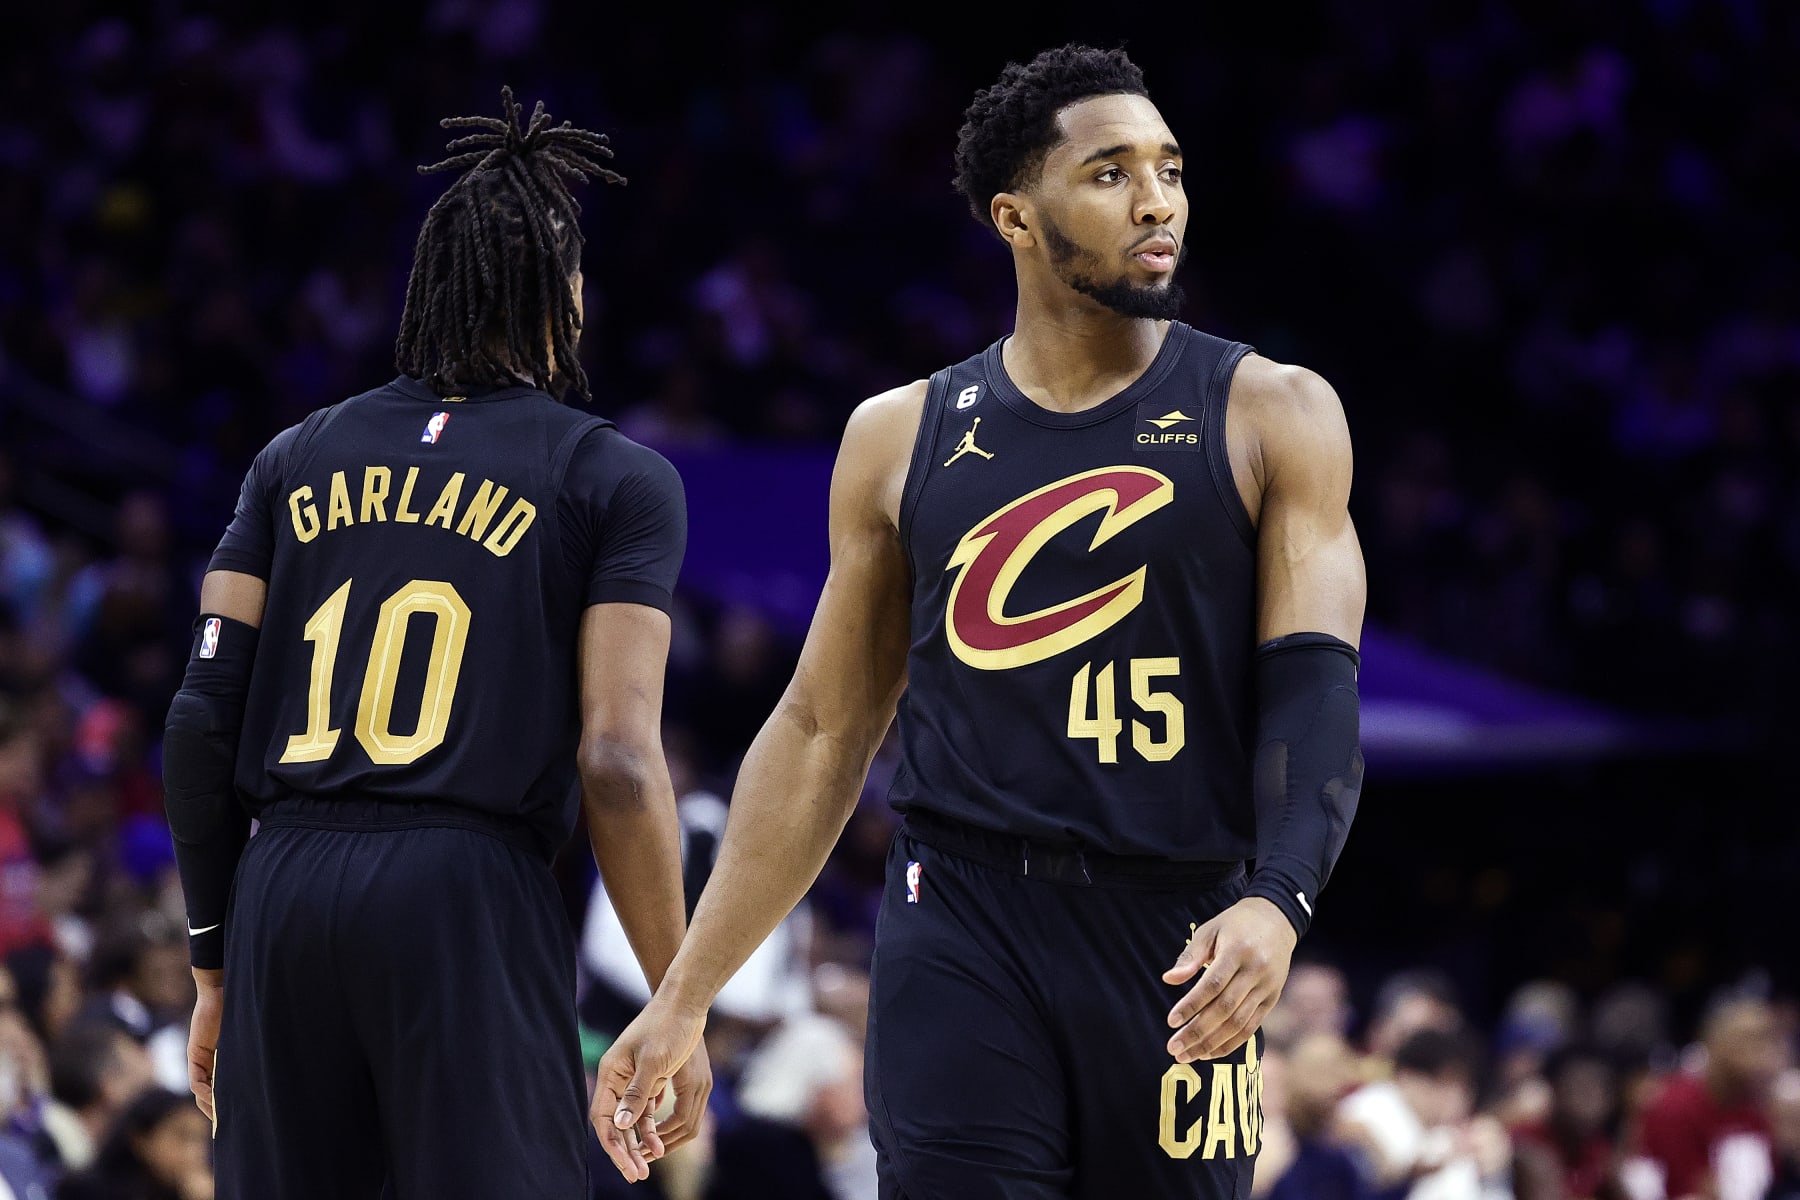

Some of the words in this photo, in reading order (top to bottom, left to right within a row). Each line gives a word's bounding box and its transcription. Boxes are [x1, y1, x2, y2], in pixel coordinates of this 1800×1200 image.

[956, 385, 979, 409] 6
[1136, 433, 1198, 444] CLIFFS
[289, 466, 536, 557] GARLAND
[945, 465, 1174, 671] C
[279, 577, 472, 765] 10
[1067, 657, 1185, 763] 45
[1158, 1063, 1264, 1159] CAV
